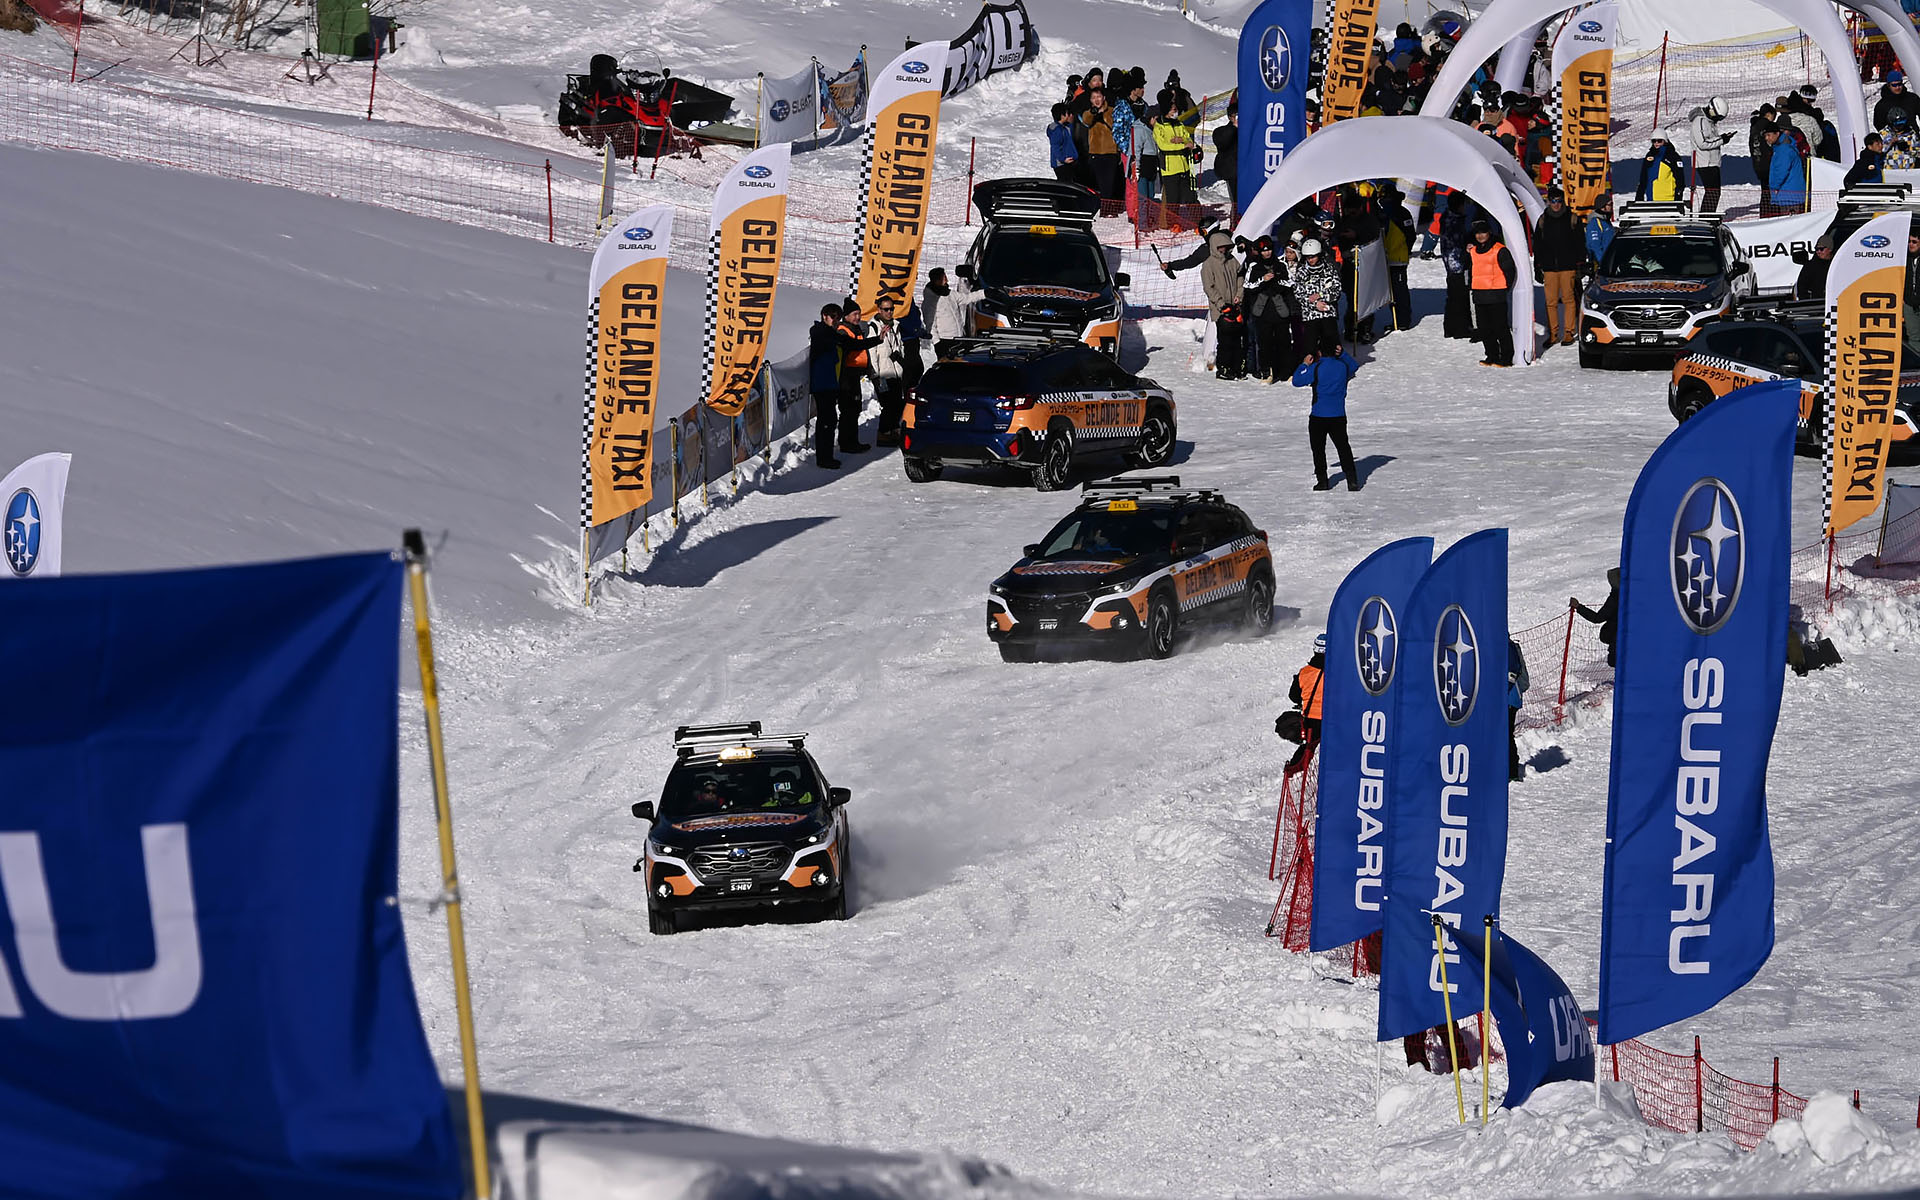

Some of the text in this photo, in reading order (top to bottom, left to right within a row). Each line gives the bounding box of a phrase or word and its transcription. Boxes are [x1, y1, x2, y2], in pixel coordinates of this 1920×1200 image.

[896, 75, 932, 84] SUBARU
[997, 52, 1020, 64] SWEDEN
[1574, 34, 1606, 43] SUBARU
[739, 181, 776, 189] SUBARU
[886, 113, 931, 236] GELANDE
[1264, 102, 1285, 180] SUB
[1579, 71, 1608, 188] GELANDE
[737, 219, 777, 345] GELANDE
[1854, 251, 1894, 259] SUBARU
[612, 283, 658, 491] GELANDE TAXI
[1085, 402, 1139, 426] GELANDE TAXI
[1844, 292, 1897, 502] GELANDE TAXI
[1355, 710, 1386, 912] SUBARU
[1429, 743, 1470, 994] SUBARU
[1669, 657, 1725, 974] SUBARU
